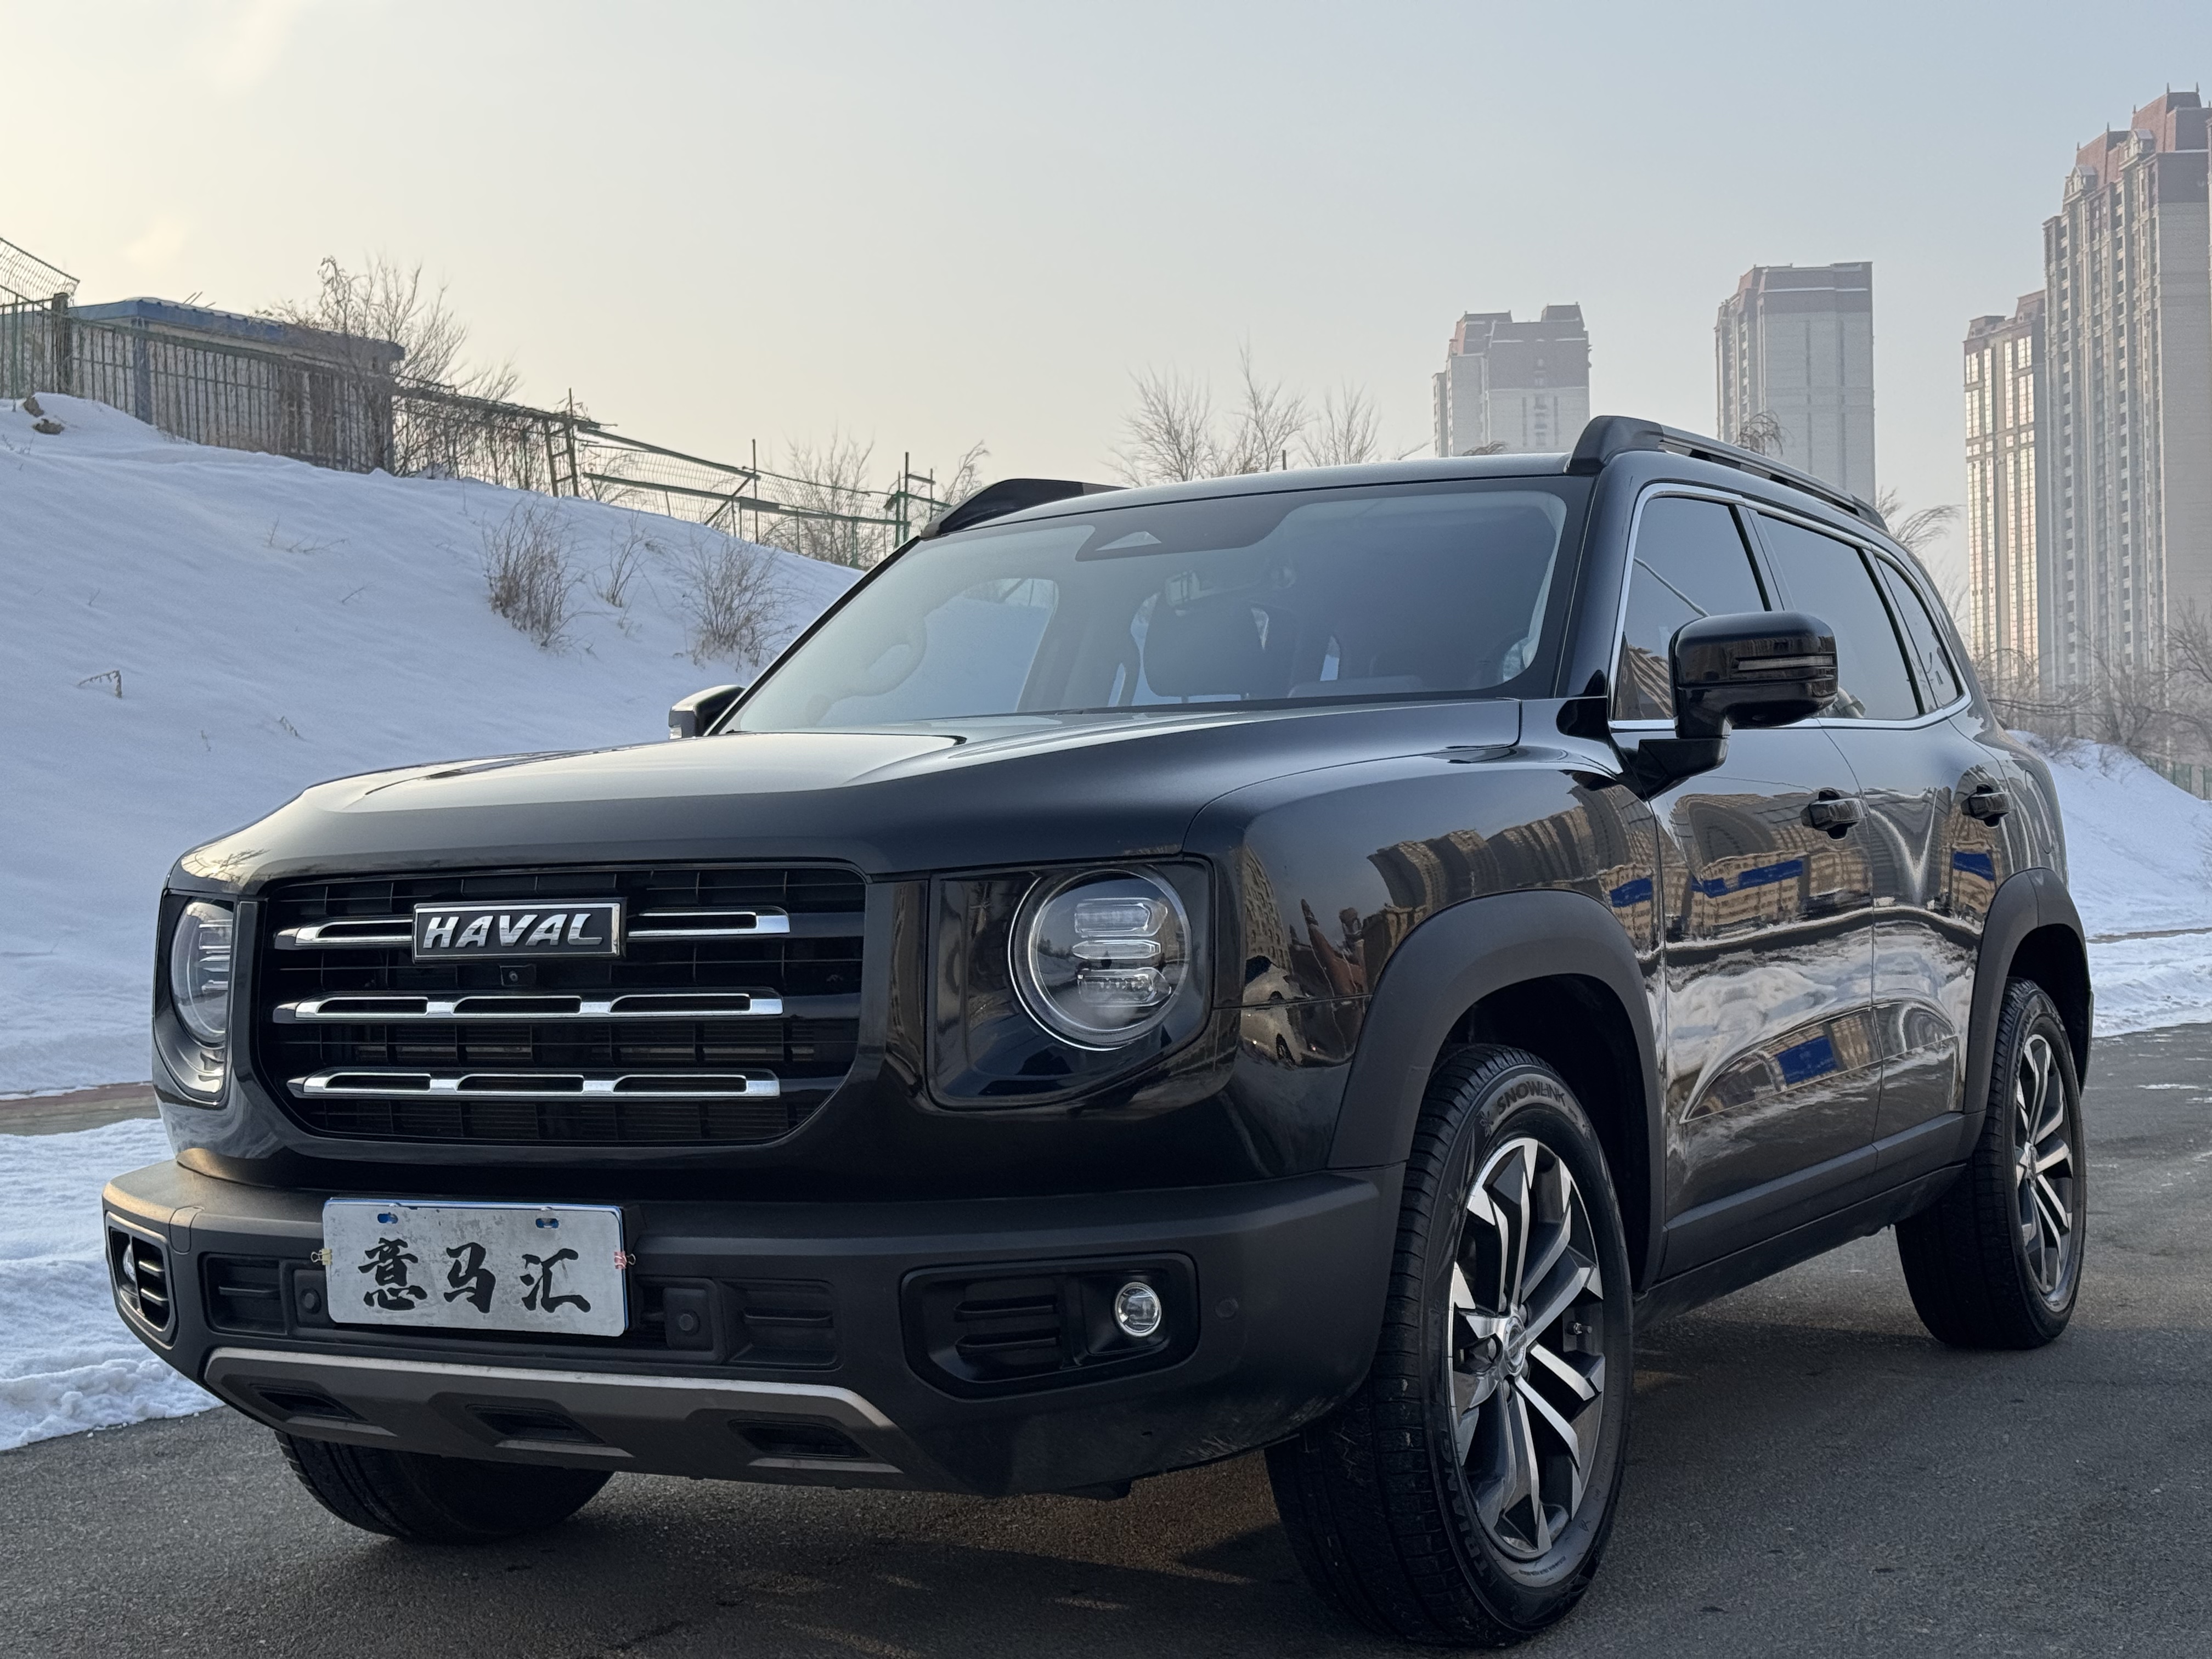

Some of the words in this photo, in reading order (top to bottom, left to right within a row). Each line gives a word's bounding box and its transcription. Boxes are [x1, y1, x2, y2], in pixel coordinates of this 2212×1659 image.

[423, 913, 603, 949] HAVAL
[1496, 1081, 1566, 1115] SNOWLINK
[358, 1238, 591, 1314] 意马汇
